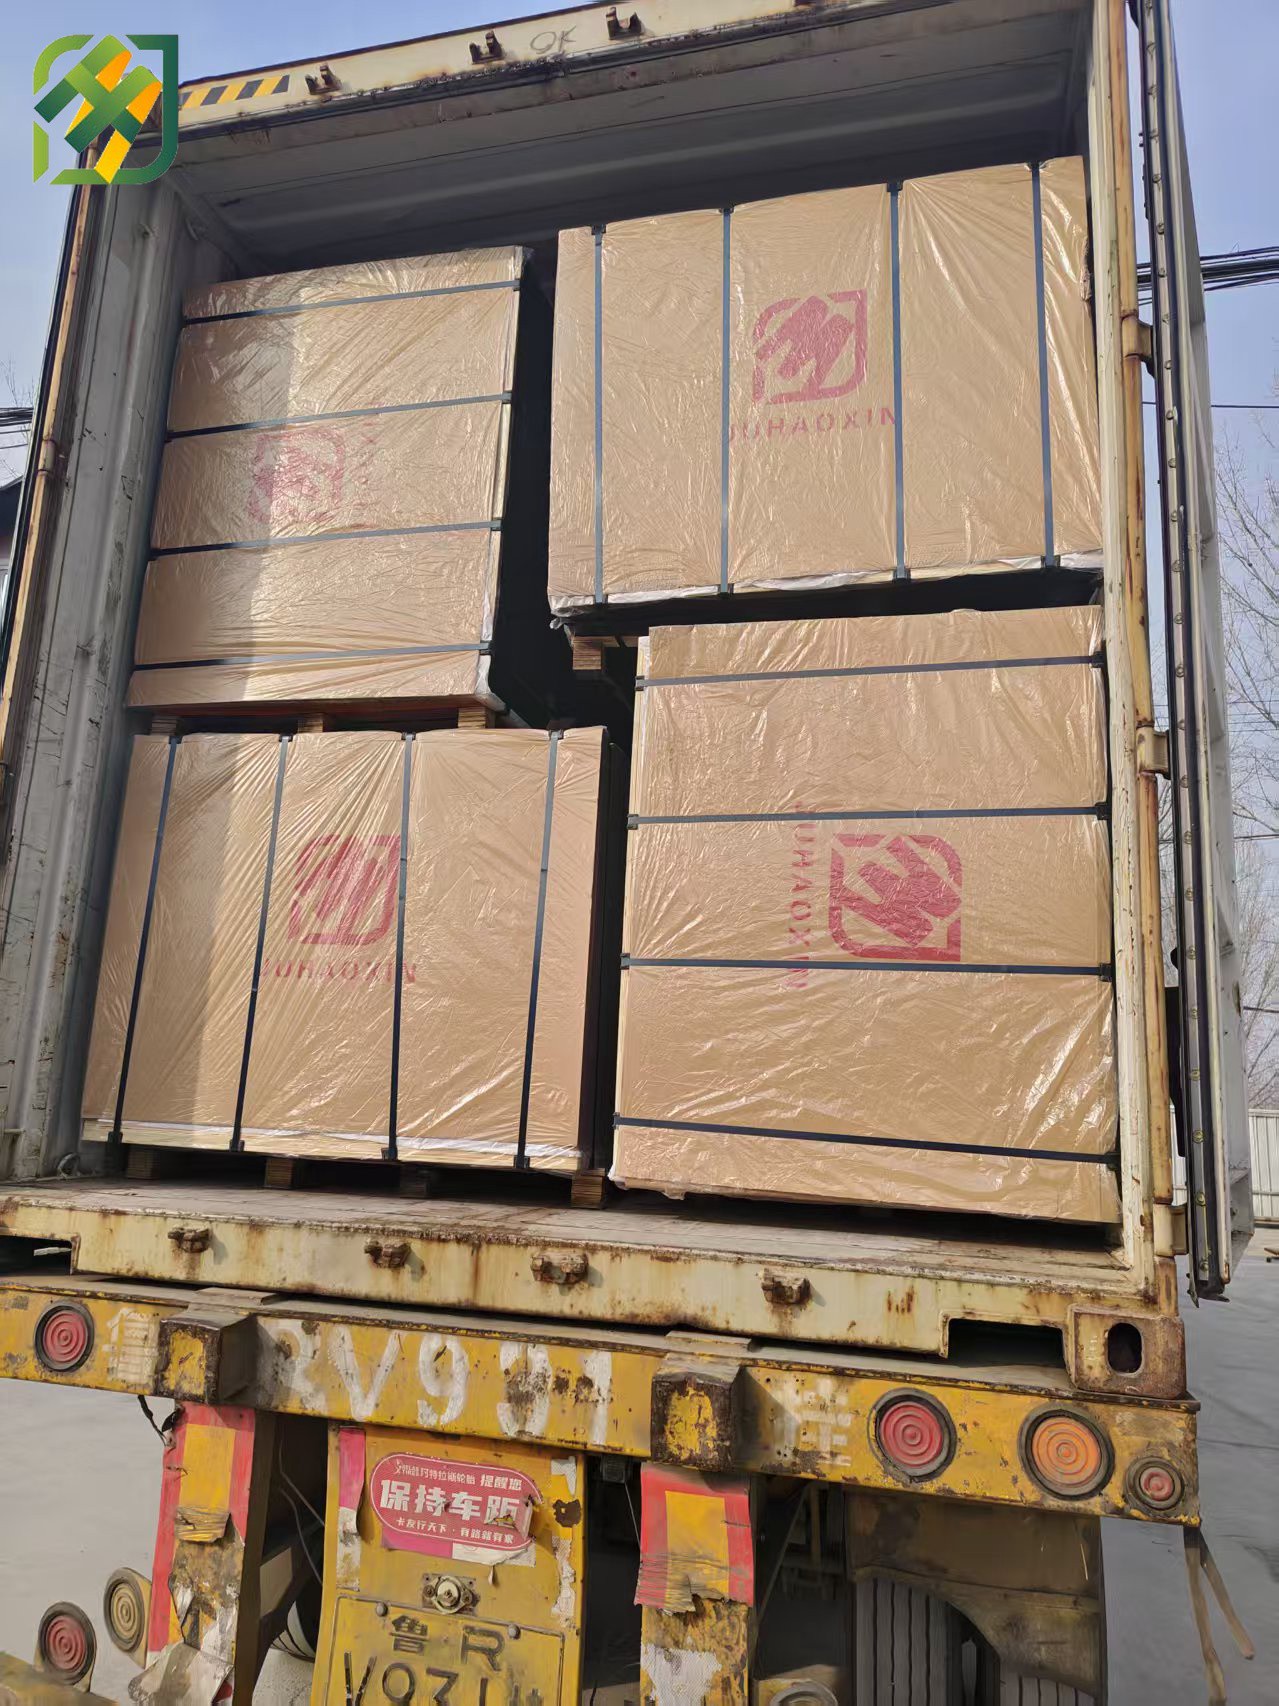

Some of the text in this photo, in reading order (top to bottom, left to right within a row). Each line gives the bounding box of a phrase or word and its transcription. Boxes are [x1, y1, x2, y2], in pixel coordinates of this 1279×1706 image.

[530, 25, 577, 55] OK
[480, 1473, 523, 1491] 提醒您
[380, 1479, 520, 1529] 保持车距
